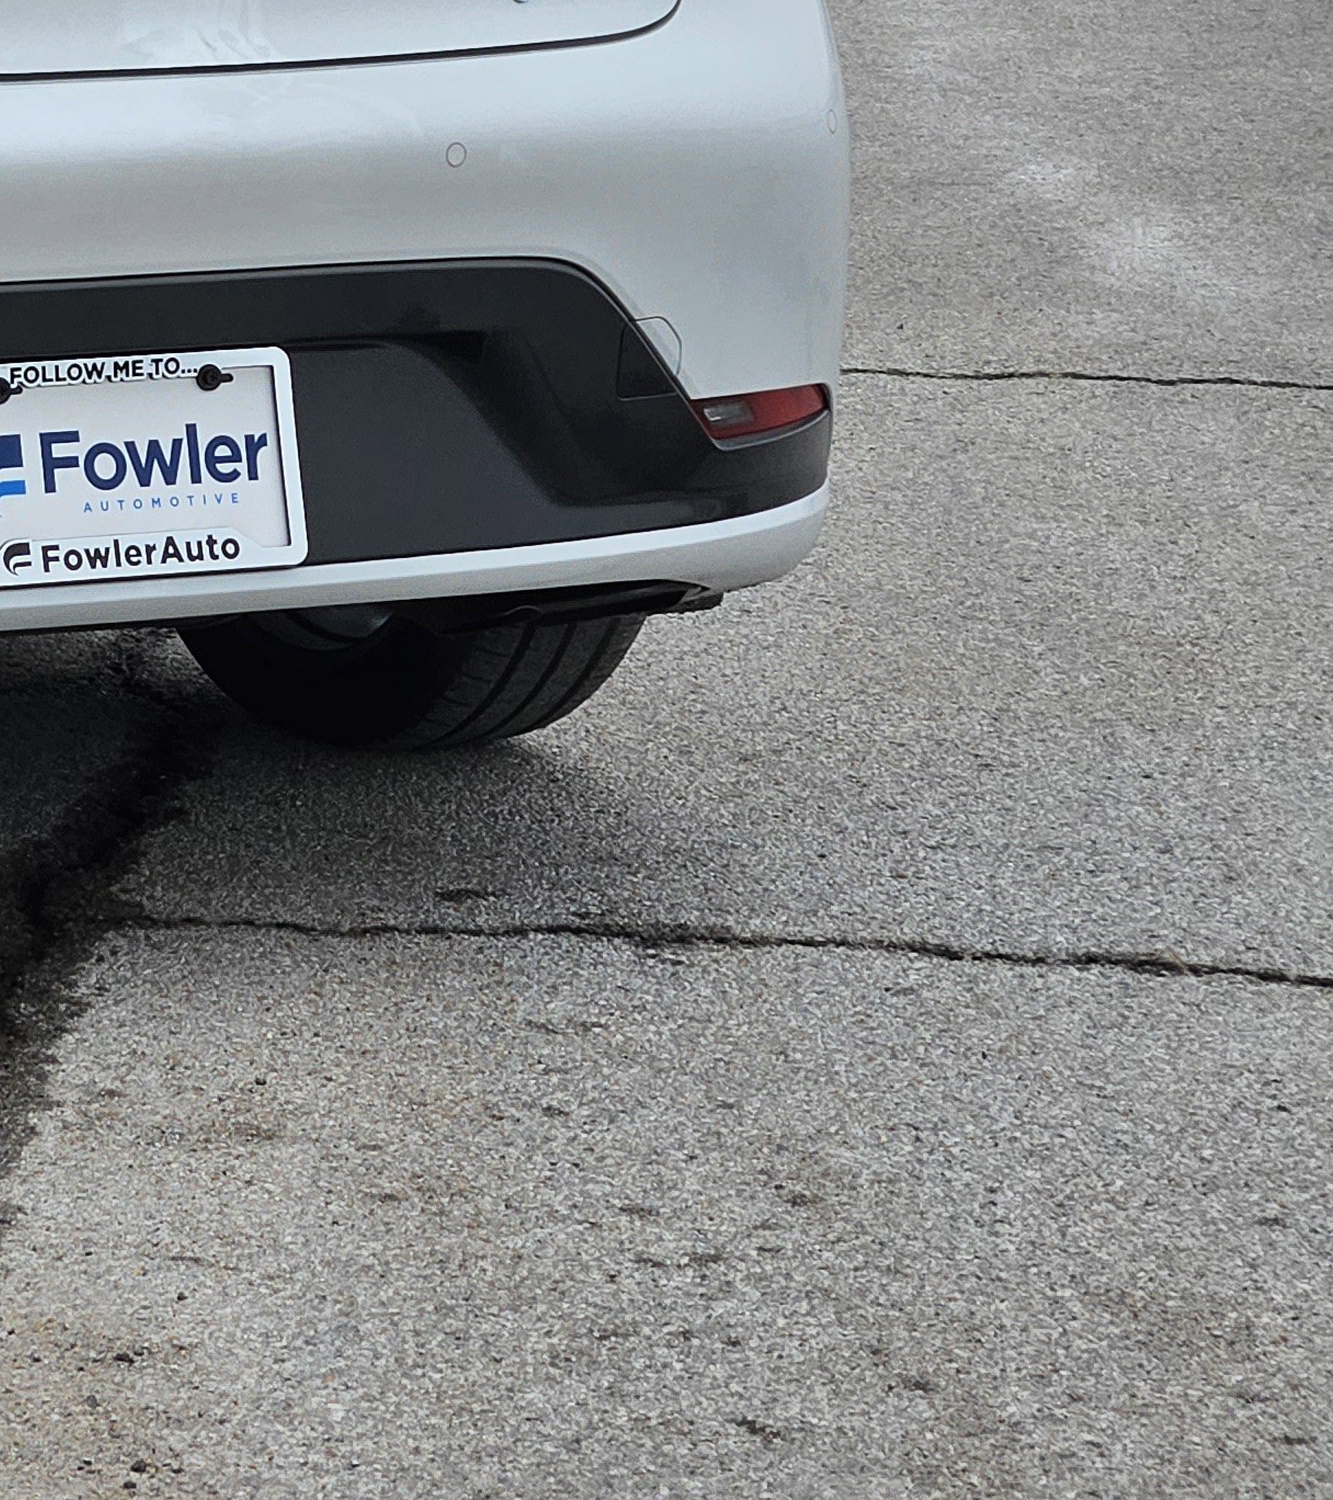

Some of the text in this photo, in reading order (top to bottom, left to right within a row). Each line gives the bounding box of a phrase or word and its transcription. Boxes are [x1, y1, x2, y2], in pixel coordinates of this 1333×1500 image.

[9, 356, 199, 385] FOLLOW ME TO...
[38, 423, 269, 494] Fowler
[83, 492, 240, 513] AUTOMOTIVE
[40, 534, 241, 573] FowlerAuto
